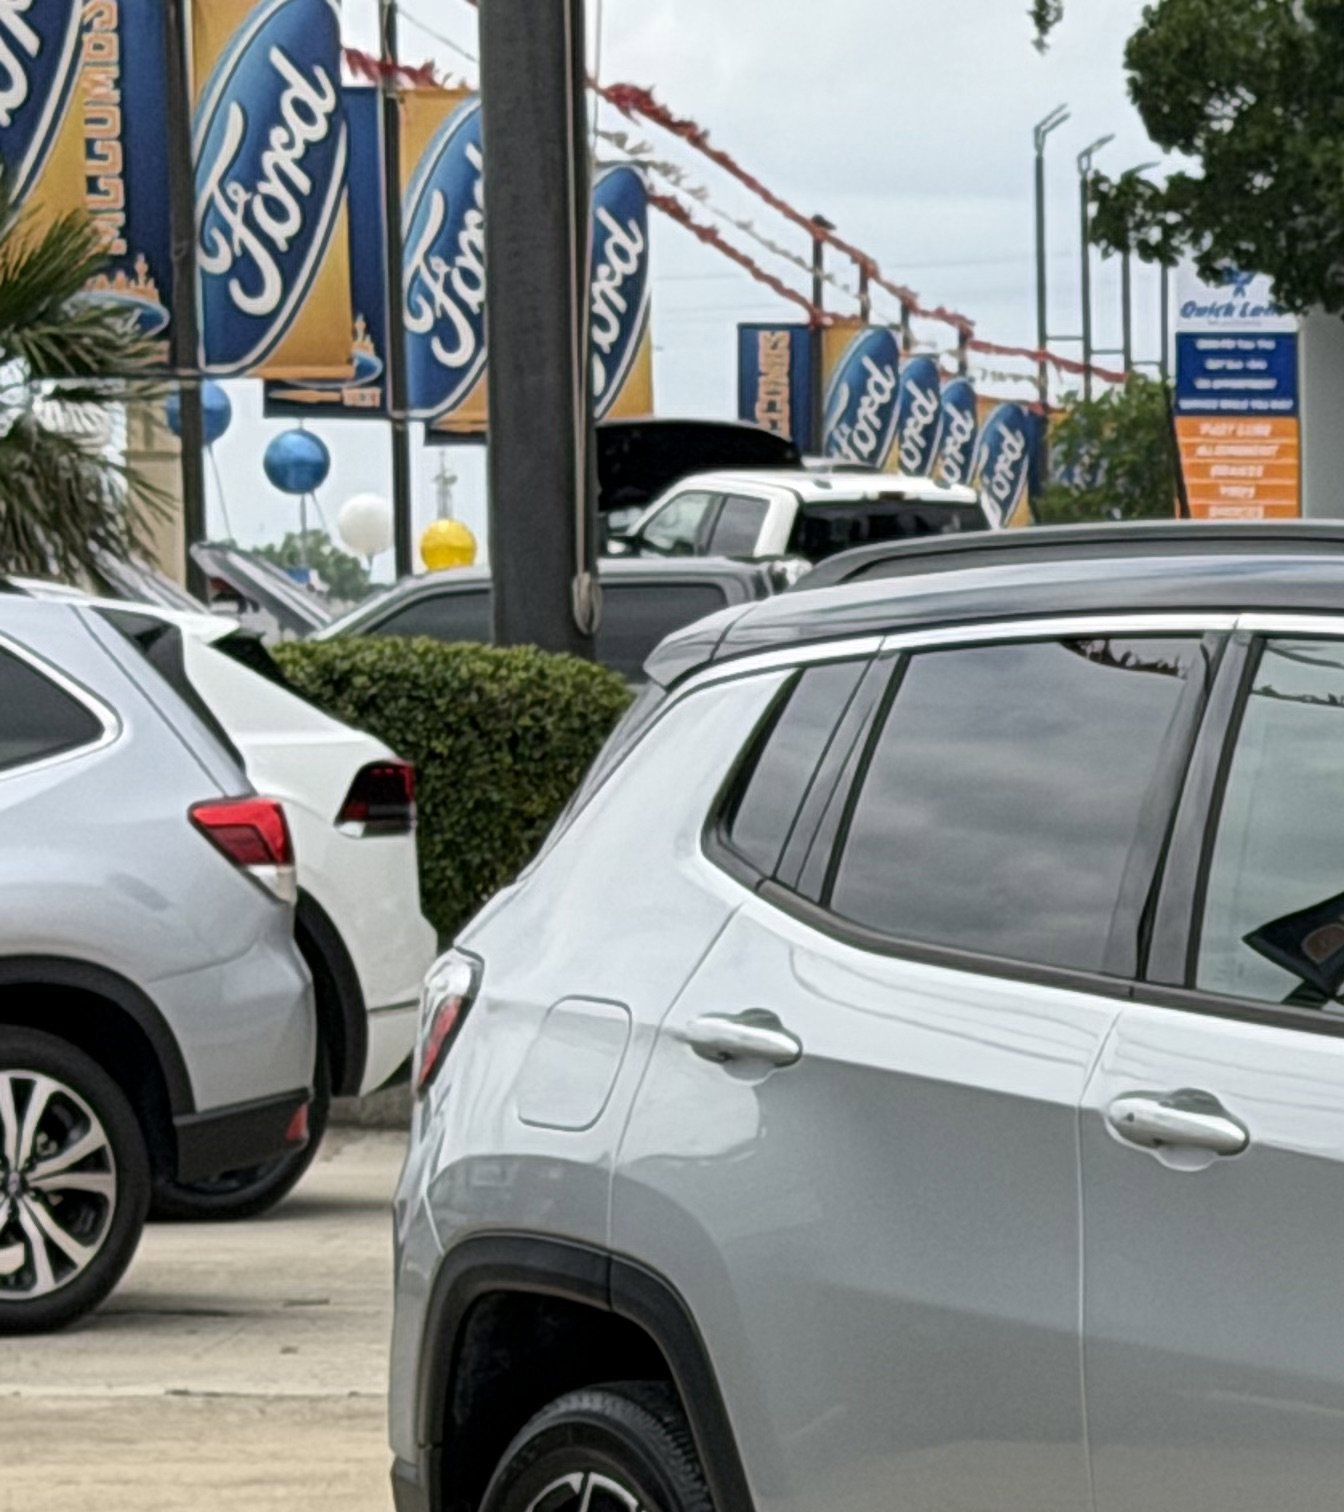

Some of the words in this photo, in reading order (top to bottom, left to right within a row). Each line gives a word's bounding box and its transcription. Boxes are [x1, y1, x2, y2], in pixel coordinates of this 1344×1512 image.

[196, 46, 336, 316] Ford
[592, 207, 644, 397] ord
[1181, 300, 1235, 319] Quick
[900, 379, 938, 470] ord
[941, 403, 974, 484] ord
